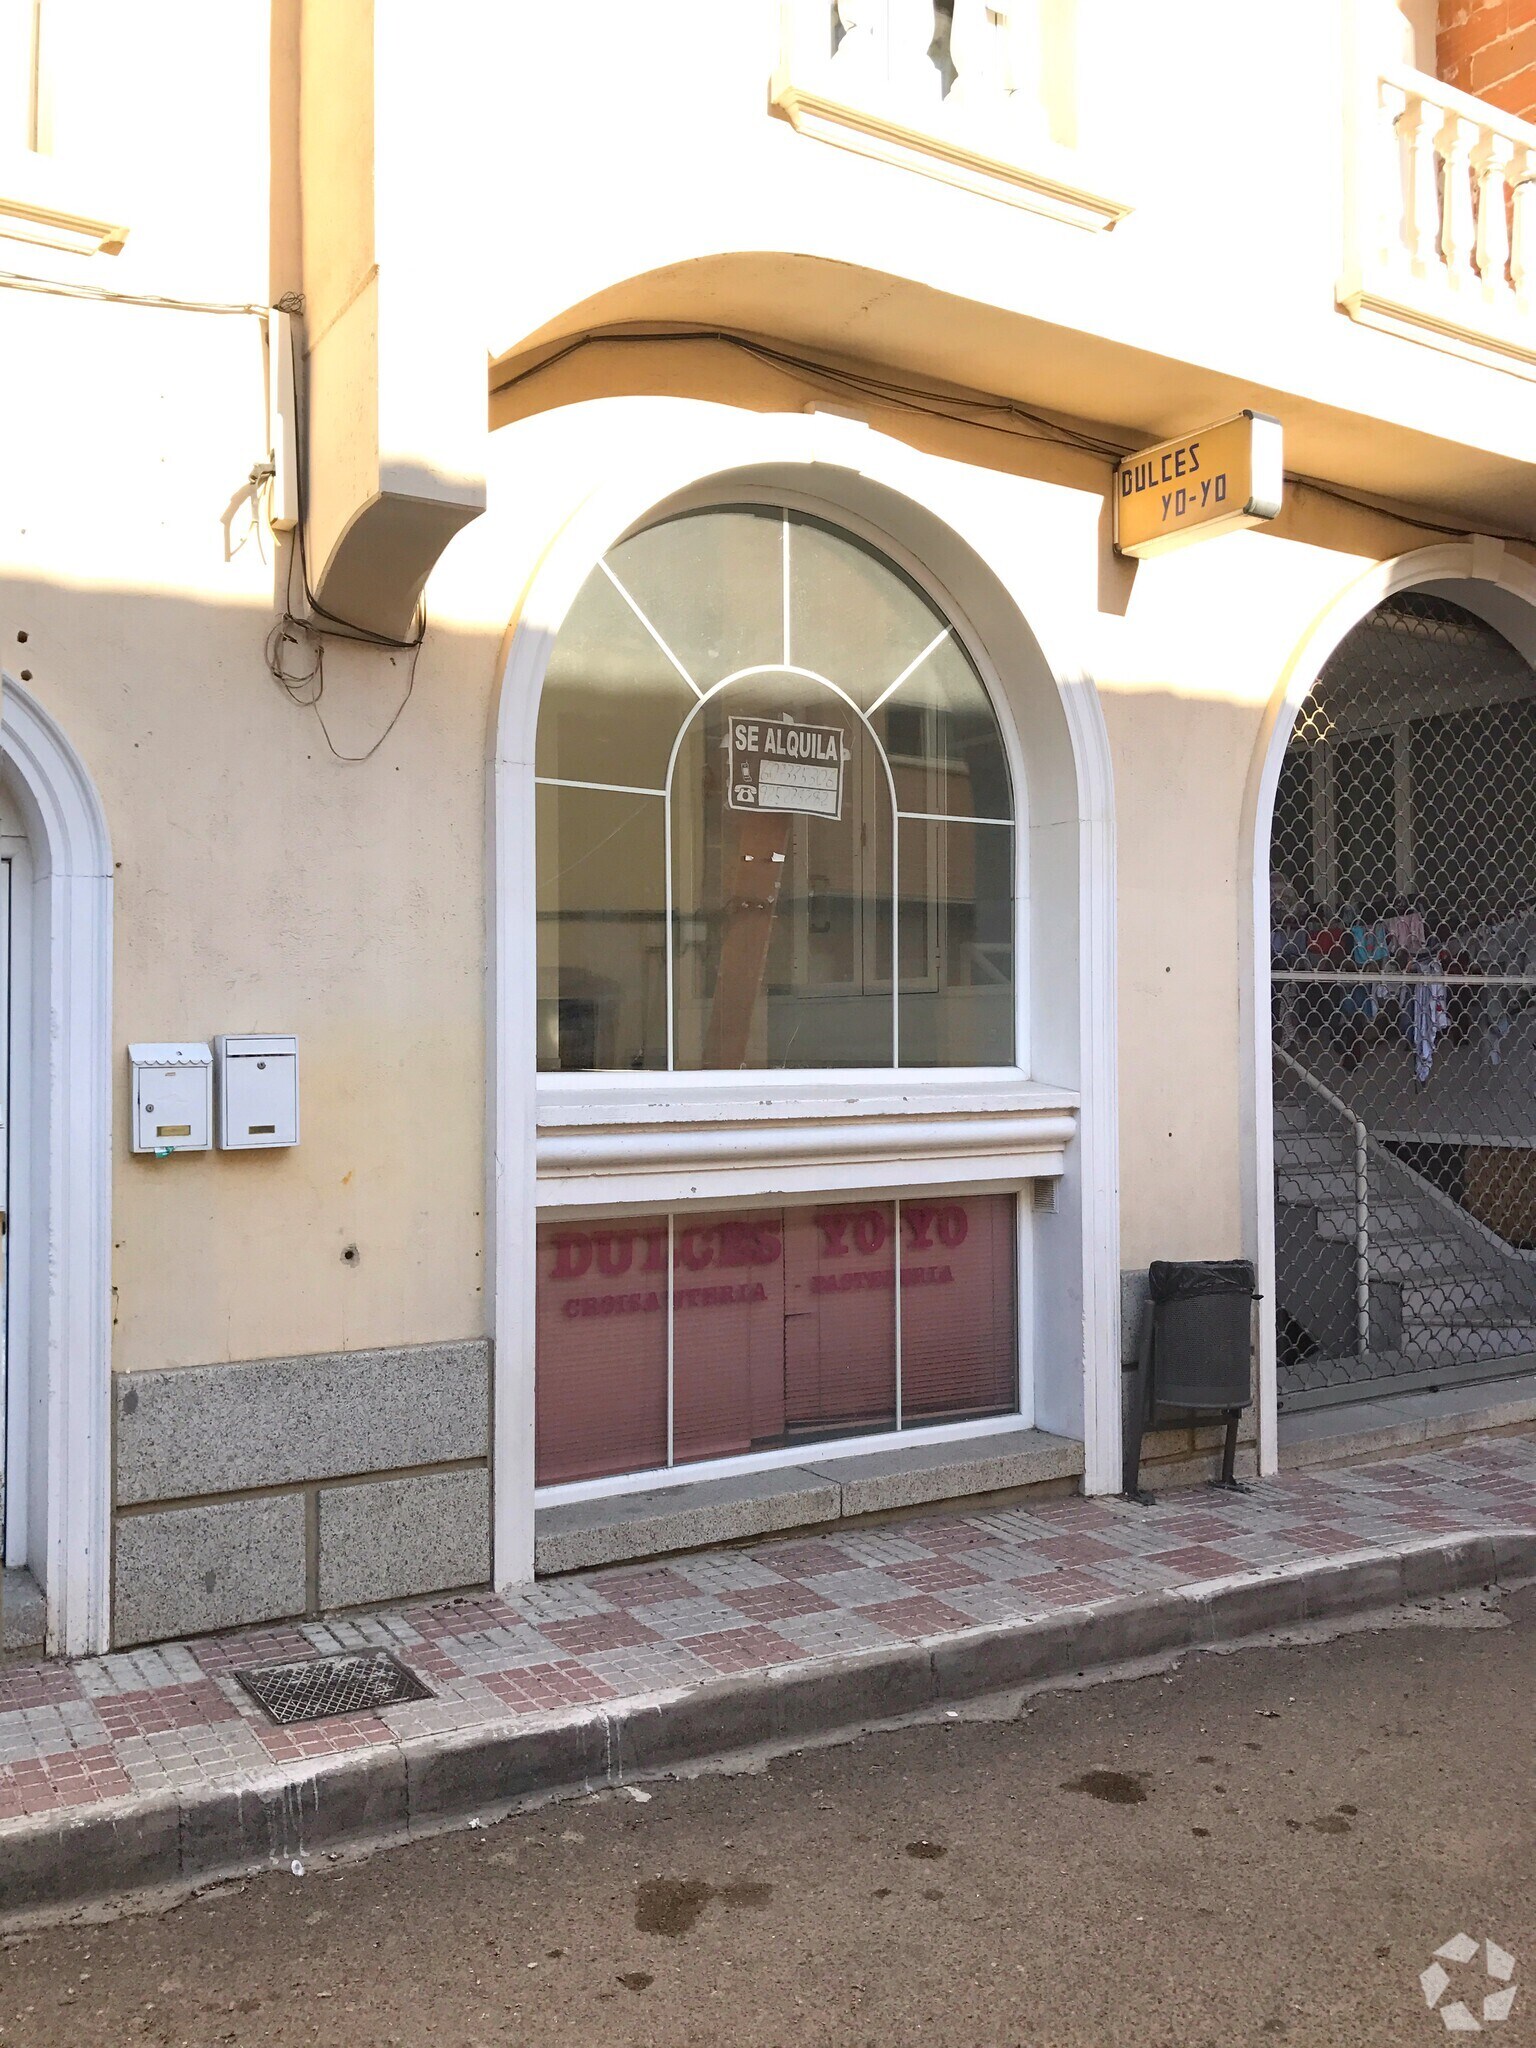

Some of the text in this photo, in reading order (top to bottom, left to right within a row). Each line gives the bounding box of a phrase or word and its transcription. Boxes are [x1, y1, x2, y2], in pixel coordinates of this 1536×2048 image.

[1122, 443, 1200, 497] DULCES
[1161, 473, 1226, 522] YO-YO
[735, 724, 838, 760] SE ALQUILA
